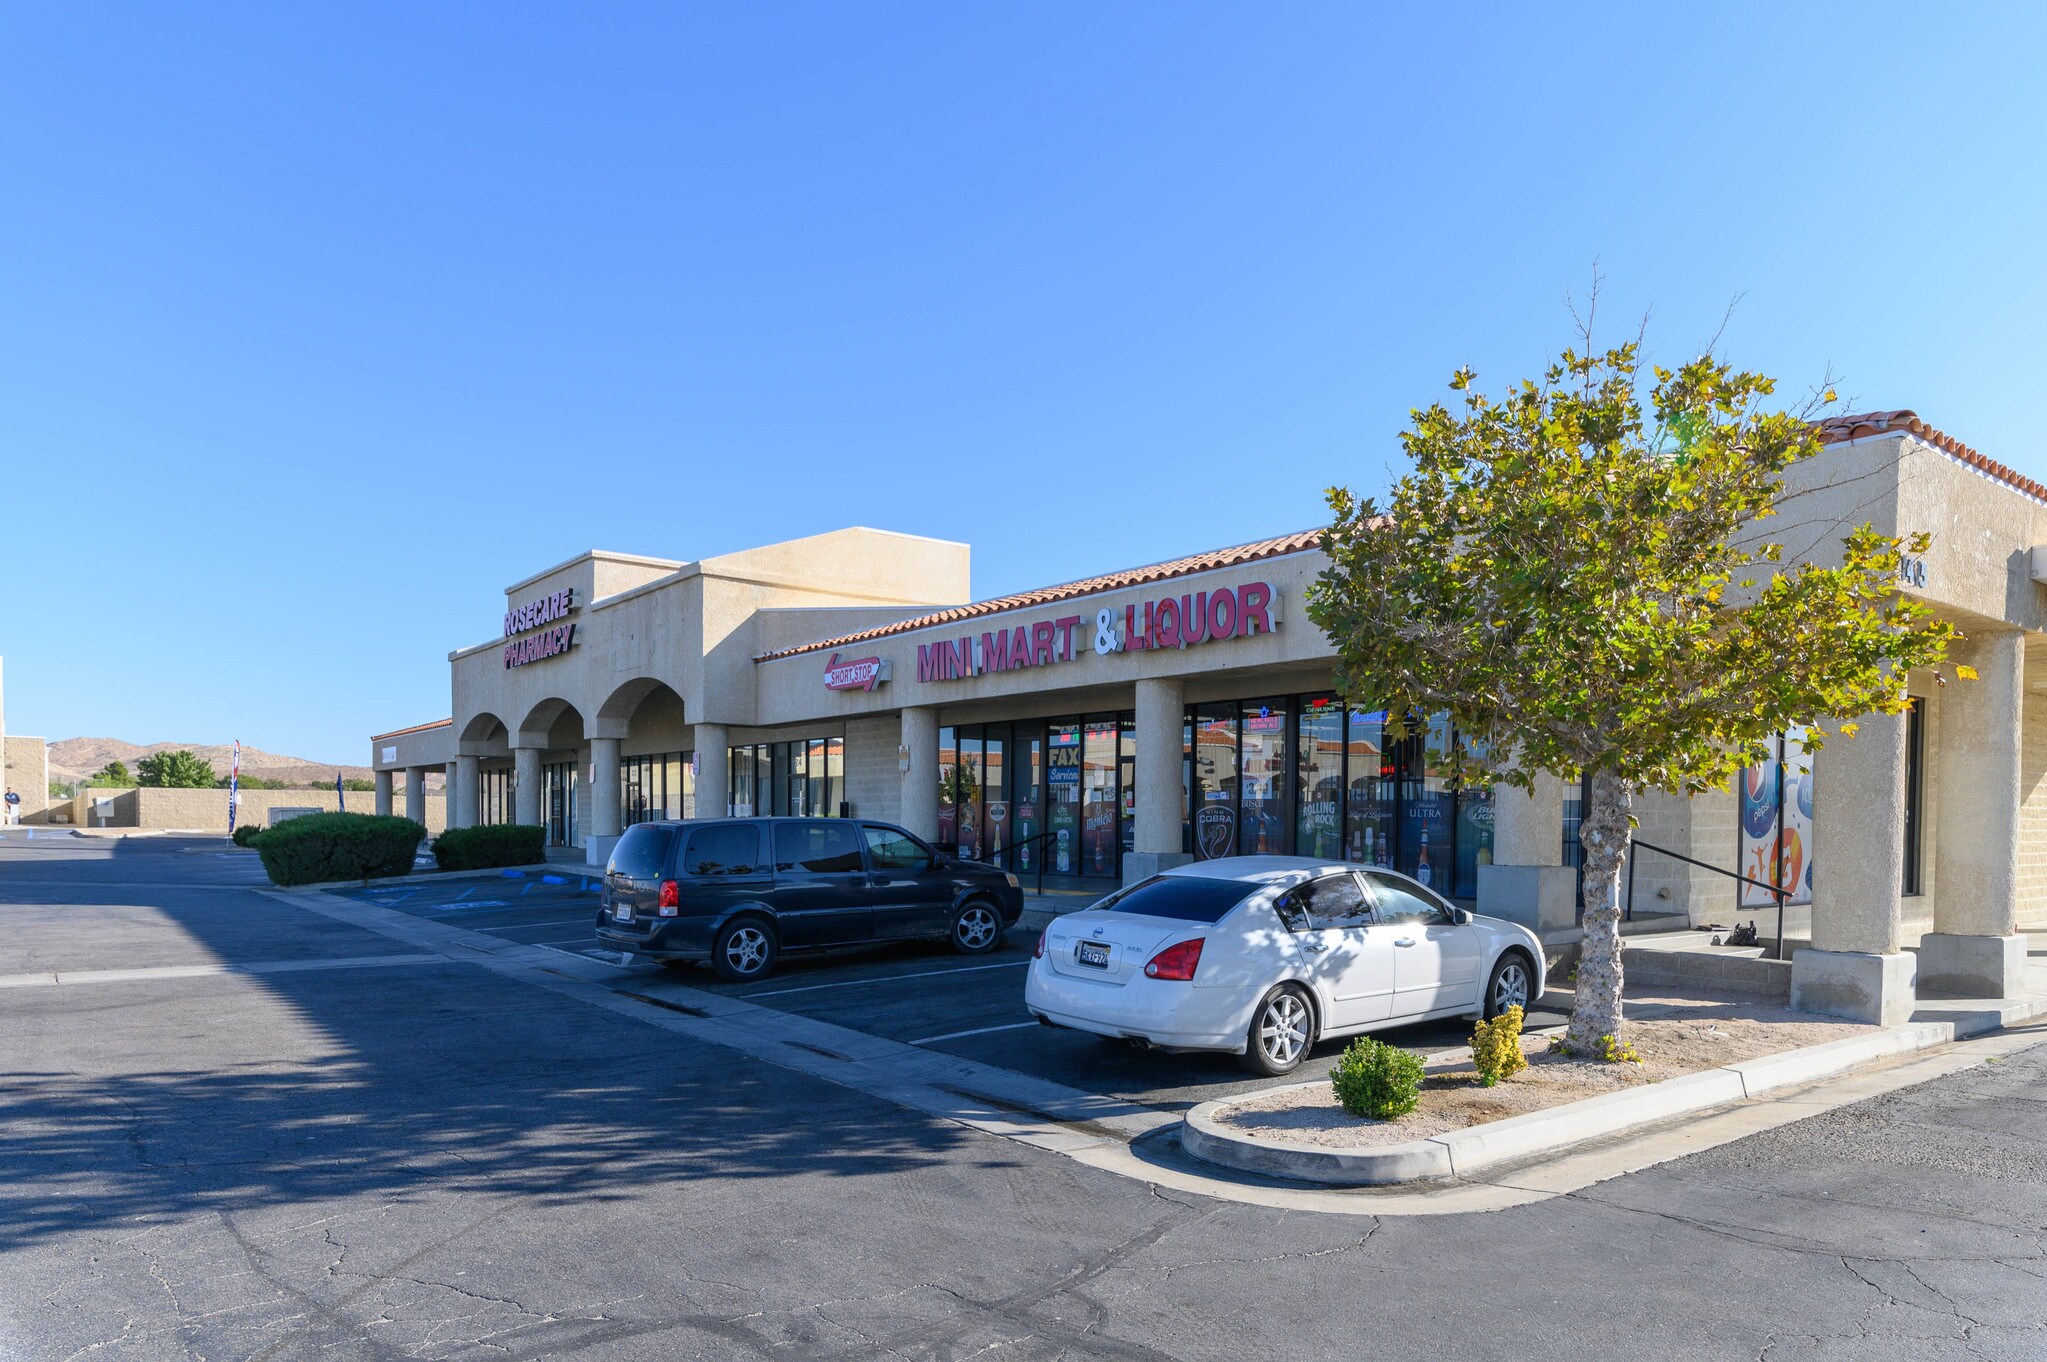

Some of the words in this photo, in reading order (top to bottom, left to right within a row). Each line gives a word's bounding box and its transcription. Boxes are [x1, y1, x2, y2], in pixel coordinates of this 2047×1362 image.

[504, 588, 571, 637] ROSECARE
[917, 636, 975, 684] MINI
[981, 615, 1083, 674] MART
[1094, 608, 1121, 656] &
[1125, 581, 1275, 651] LIQUOR
[503, 624, 574, 670] PHARMACY
[831, 667, 853, 686] SHORT
[854, 663, 872, 682] STOP
[1048, 747, 1079, 767] FAX
[1241, 799, 1264, 808] BUSCH
[1303, 801, 1335, 818] ROLLING
[1409, 808, 1442, 818] ULTRA
[1754, 801, 1770, 823] pepsi
[1199, 815, 1233, 824] COBRA
[1315, 814, 1335, 827] ROCK
